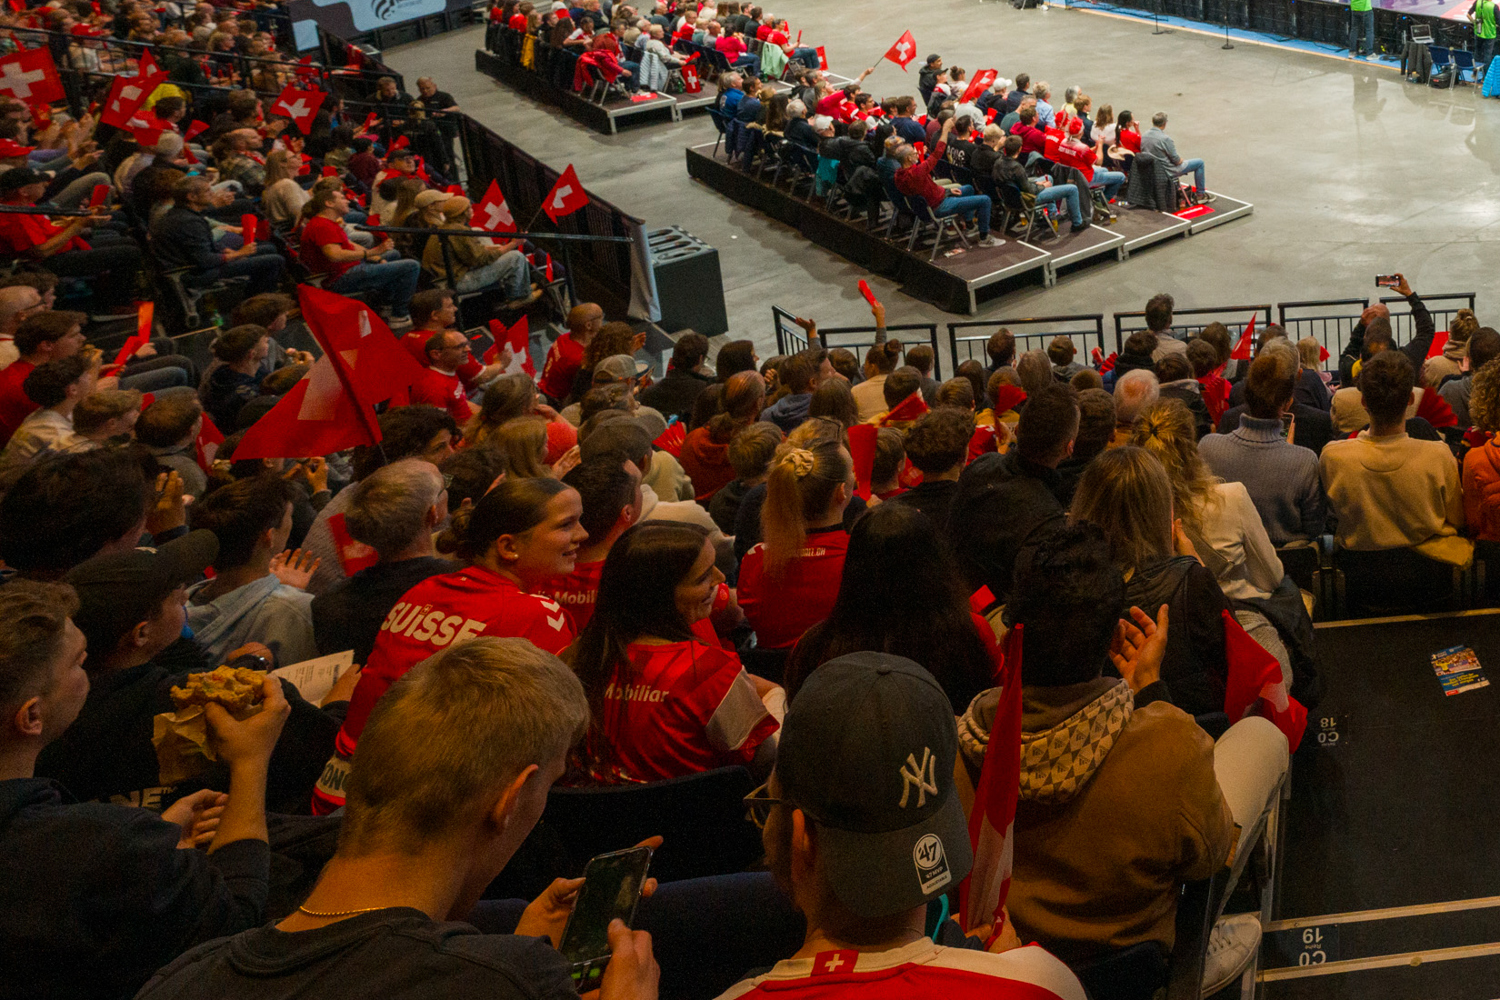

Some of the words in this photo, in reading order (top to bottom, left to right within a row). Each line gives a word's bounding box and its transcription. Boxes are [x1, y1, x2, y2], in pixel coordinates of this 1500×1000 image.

[1319, 717, 1337, 728] 18
[899, 746, 939, 808] NY
[1302, 927, 1324, 944] 19
